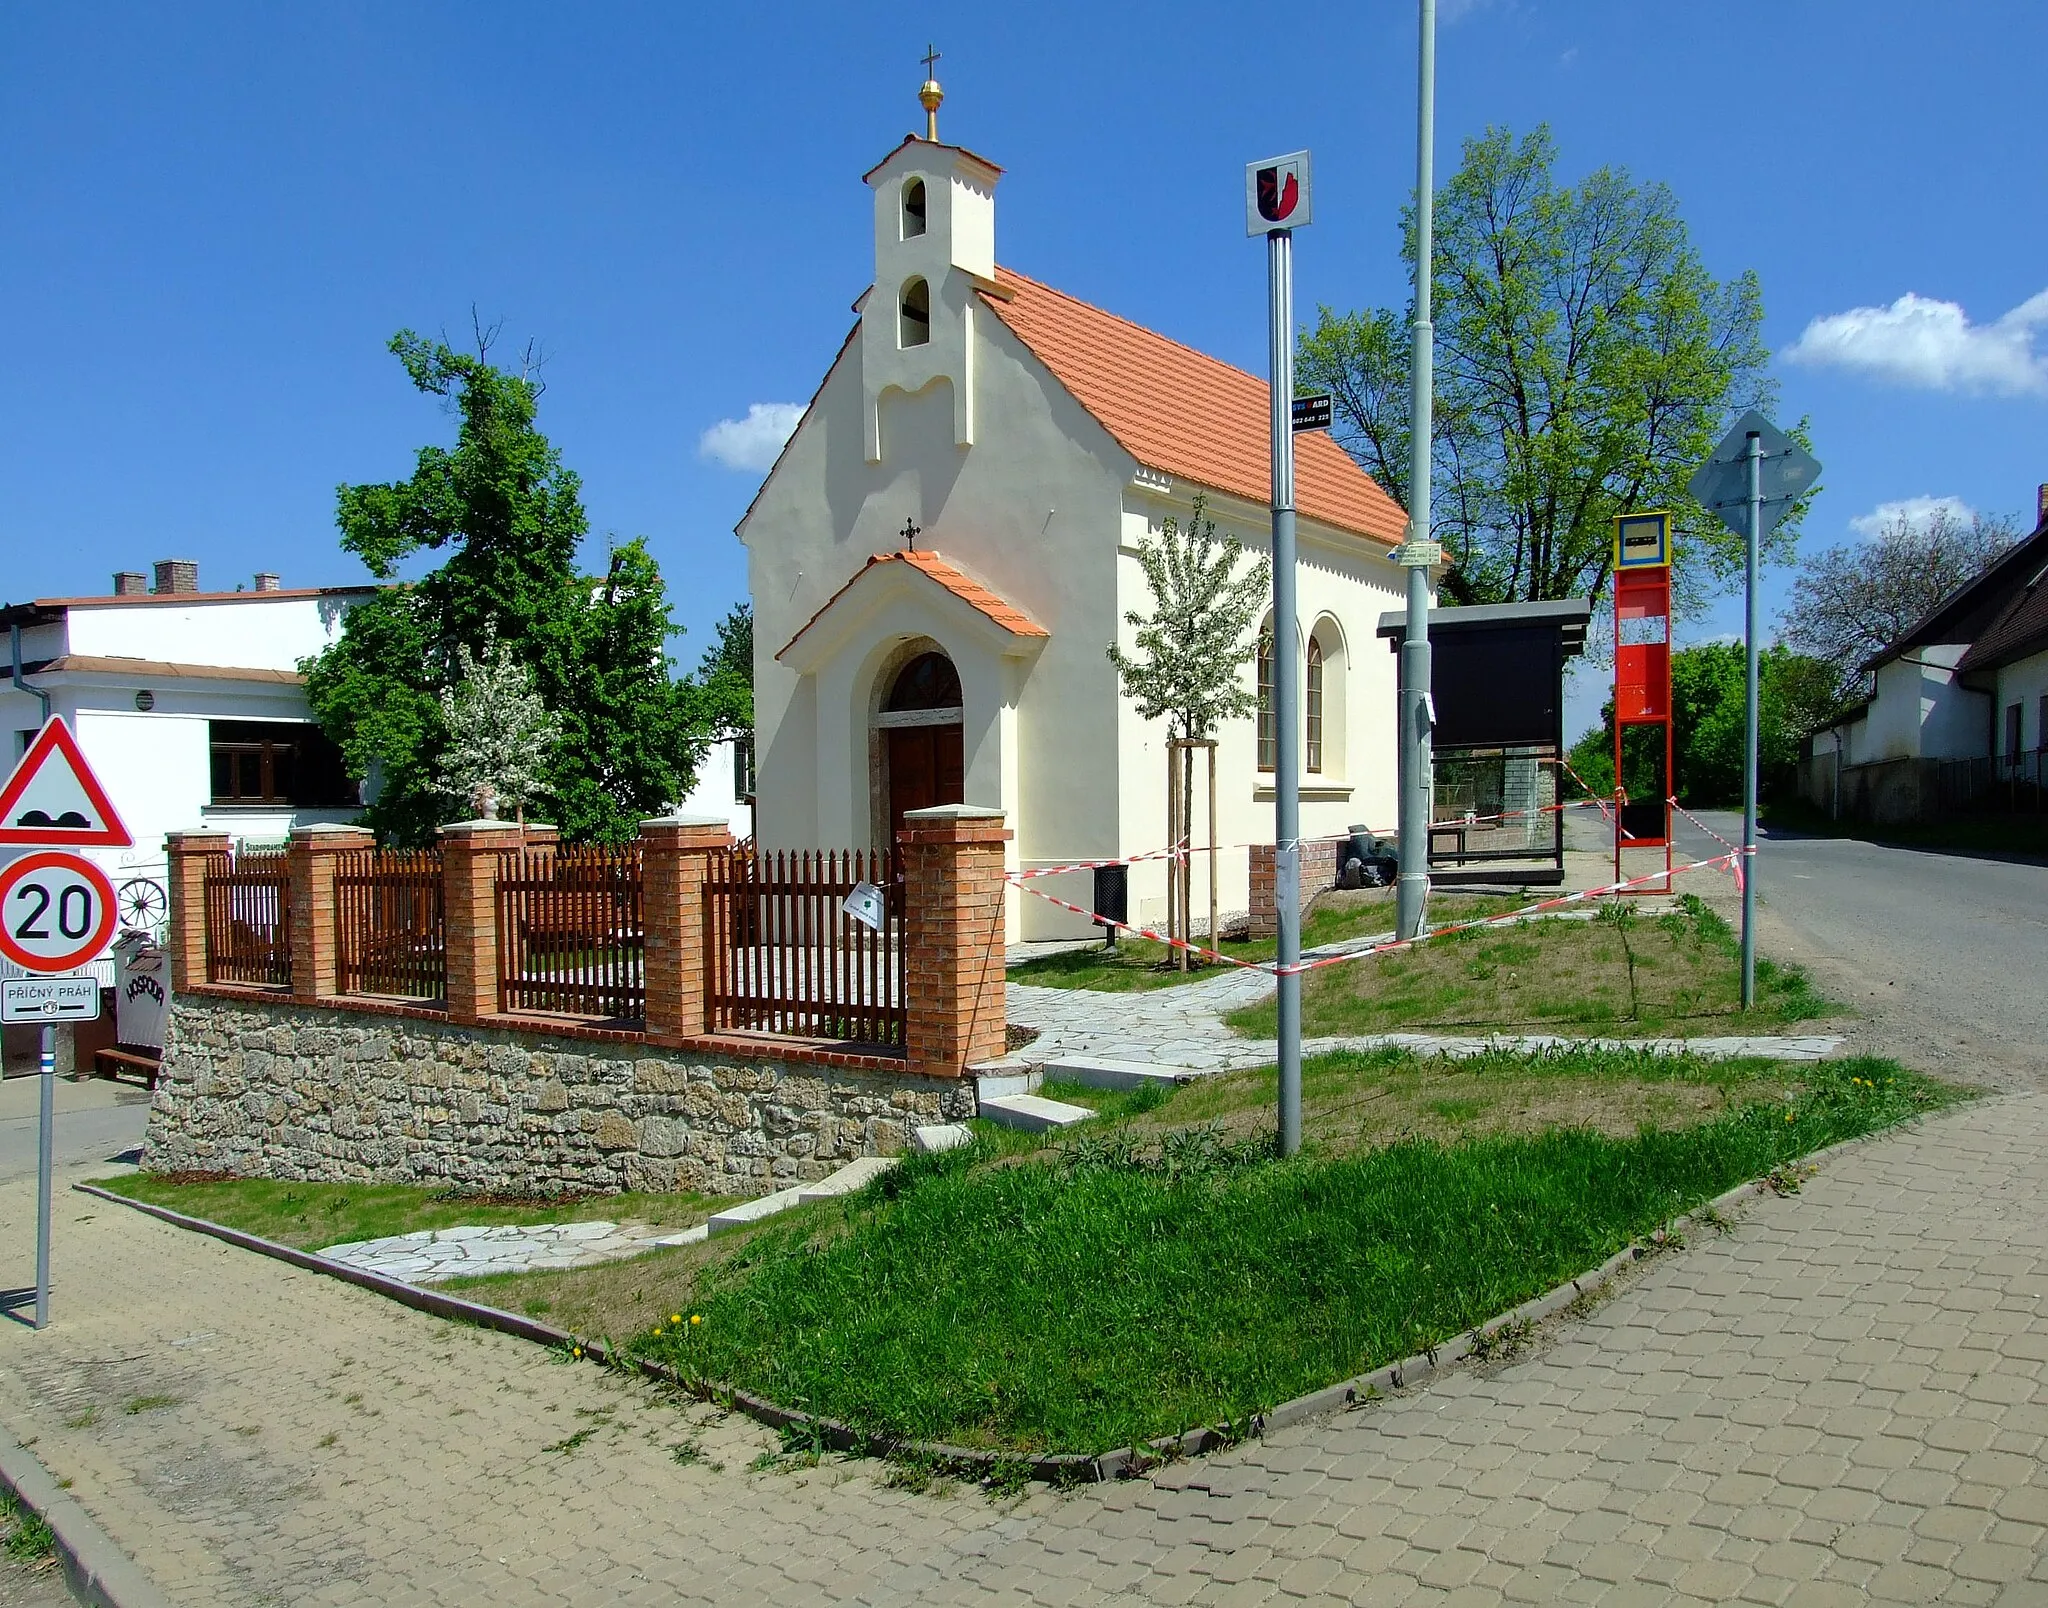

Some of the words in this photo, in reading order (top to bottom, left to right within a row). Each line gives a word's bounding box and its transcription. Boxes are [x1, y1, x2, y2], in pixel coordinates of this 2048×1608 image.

[16, 884, 92, 939] 20
[8, 986, 53, 999] PŘÍČNÝ
[59, 985, 91, 997] PRÁH
[126, 975, 164, 1007] HOSPODA
